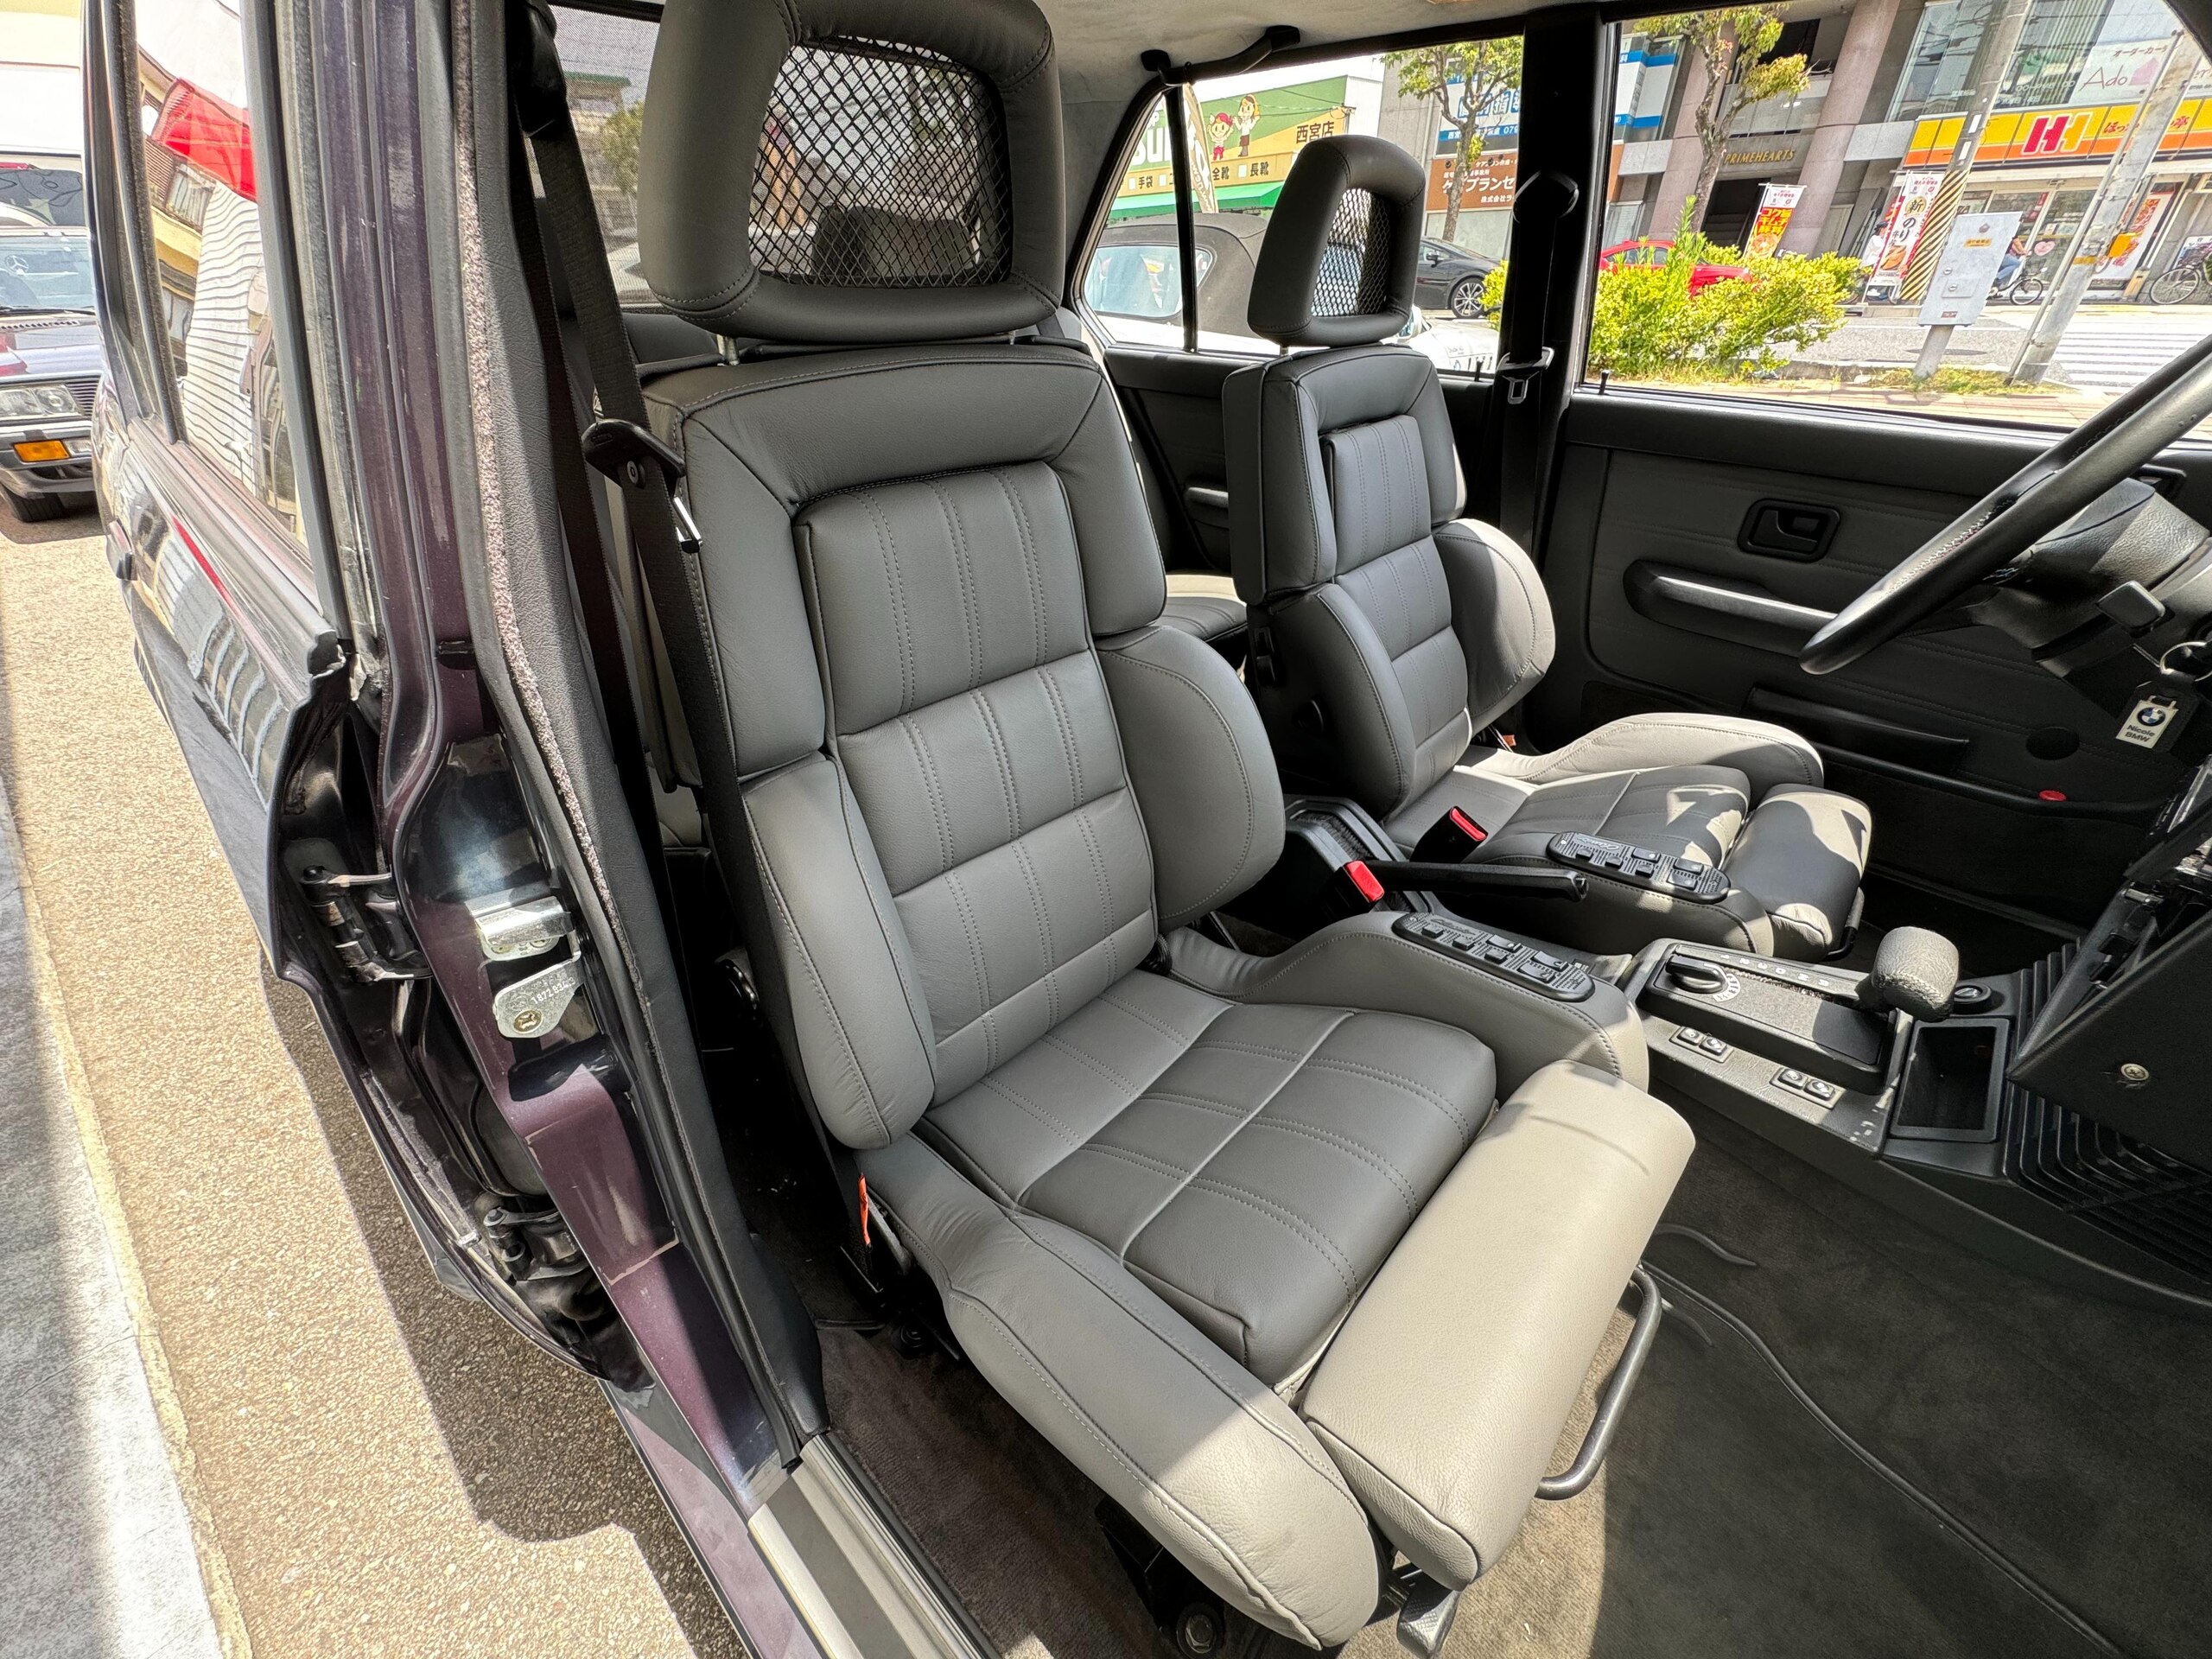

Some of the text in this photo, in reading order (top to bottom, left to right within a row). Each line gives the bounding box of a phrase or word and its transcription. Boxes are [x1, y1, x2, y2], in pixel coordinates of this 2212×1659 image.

[2077, 66, 2129, 92] Ado
[1296, 121, 1334, 144] 西宮店
[1724, 149, 1796, 165] PRIMEHEARTS
[1211, 166, 1230, 181] 全靴
[1138, 175, 1154, 189] 手袋
[1442, 175, 1516, 194] ケプランセ
[2125, 732, 2150, 741] BMW
[2126, 725, 2154, 736] Nicole
[531, 988, 554, 1004] 1872
